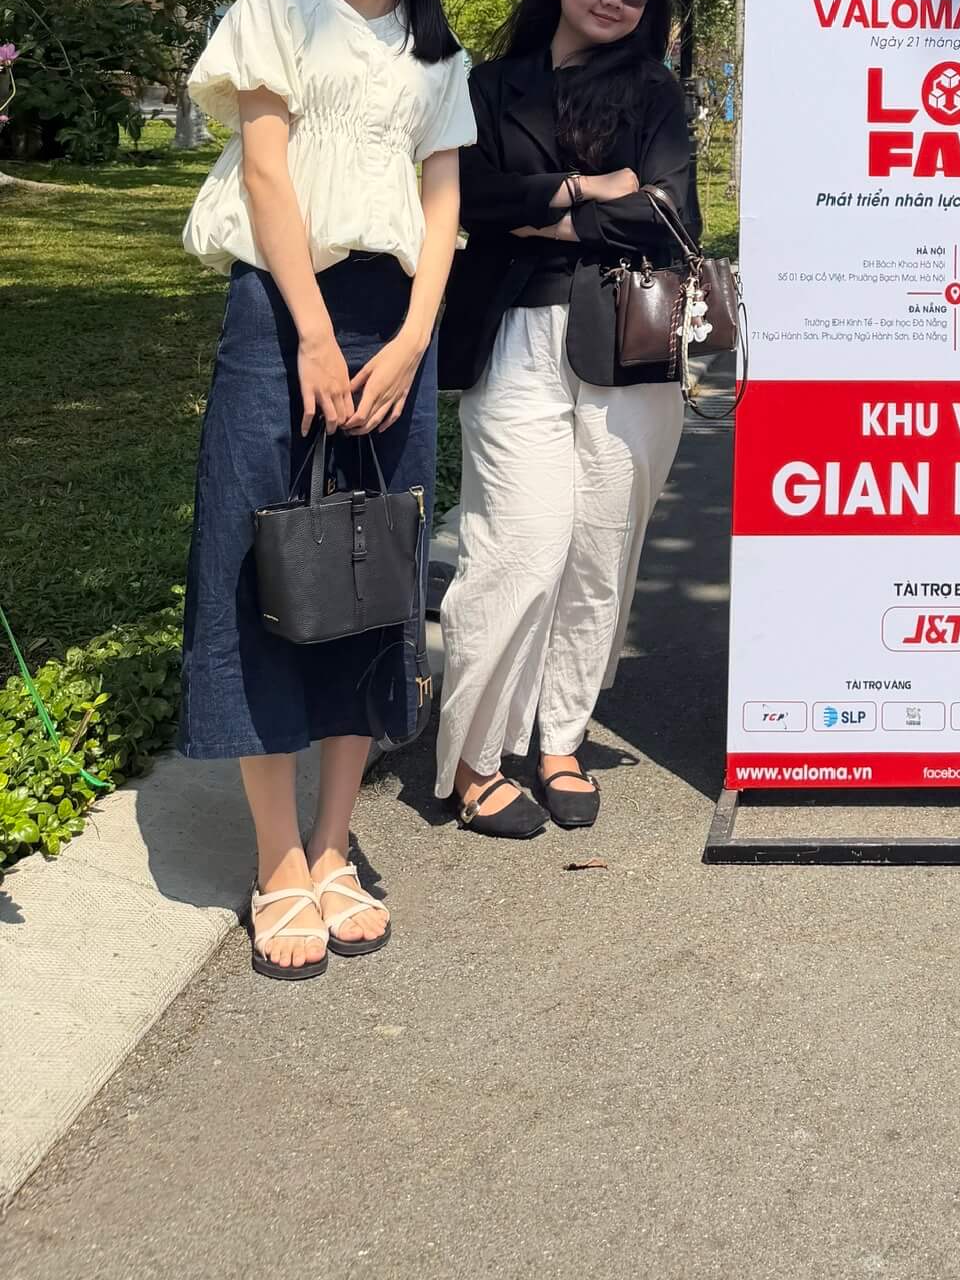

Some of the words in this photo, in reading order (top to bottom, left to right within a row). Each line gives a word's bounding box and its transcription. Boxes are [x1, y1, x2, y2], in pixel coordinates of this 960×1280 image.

[870, 36, 903, 49] Ngày
[906, 37, 920, 48] 21
[924, 37, 960, 50] tháng
[816, 192, 852, 207] Phát
[856, 188, 890, 207] triển
[894, 193, 933, 207] nhân
[916, 246, 929, 255] HÀ
[930, 247, 946, 256] NỘI
[863, 260, 875, 268] ĐH
[876, 259, 897, 268] Bách
[899, 260, 919, 268] Khoa
[920, 259, 931, 268] Hà
[932, 260, 945, 270] Nội
[789, 273, 798, 281] 01
[919, 273, 931, 282] Hà
[932, 273, 945, 283] Nội
[908, 304, 921, 313] ĐÀ
[922, 302, 948, 314] NẴNG
[846, 318, 862, 327] Kinh
[895, 318, 911, 328] học
[912, 318, 925, 327] Đà
[752, 332, 760, 340] 71
[912, 331, 924, 341] Đà
[861, 402, 939, 436] KHU
[771, 461, 930, 516] GIAN
[894, 580, 918, 596] TÀI
[921, 583, 951, 599] TRỢ
[846, 679, 862, 690] TÀI
[863, 680, 883, 691] TRỢ
[883, 679, 912, 690] VÀNG
[762, 712, 785, 722] TCP
[841, 711, 866, 724] SLP
[736, 764, 873, 780] www.valoma.vn
